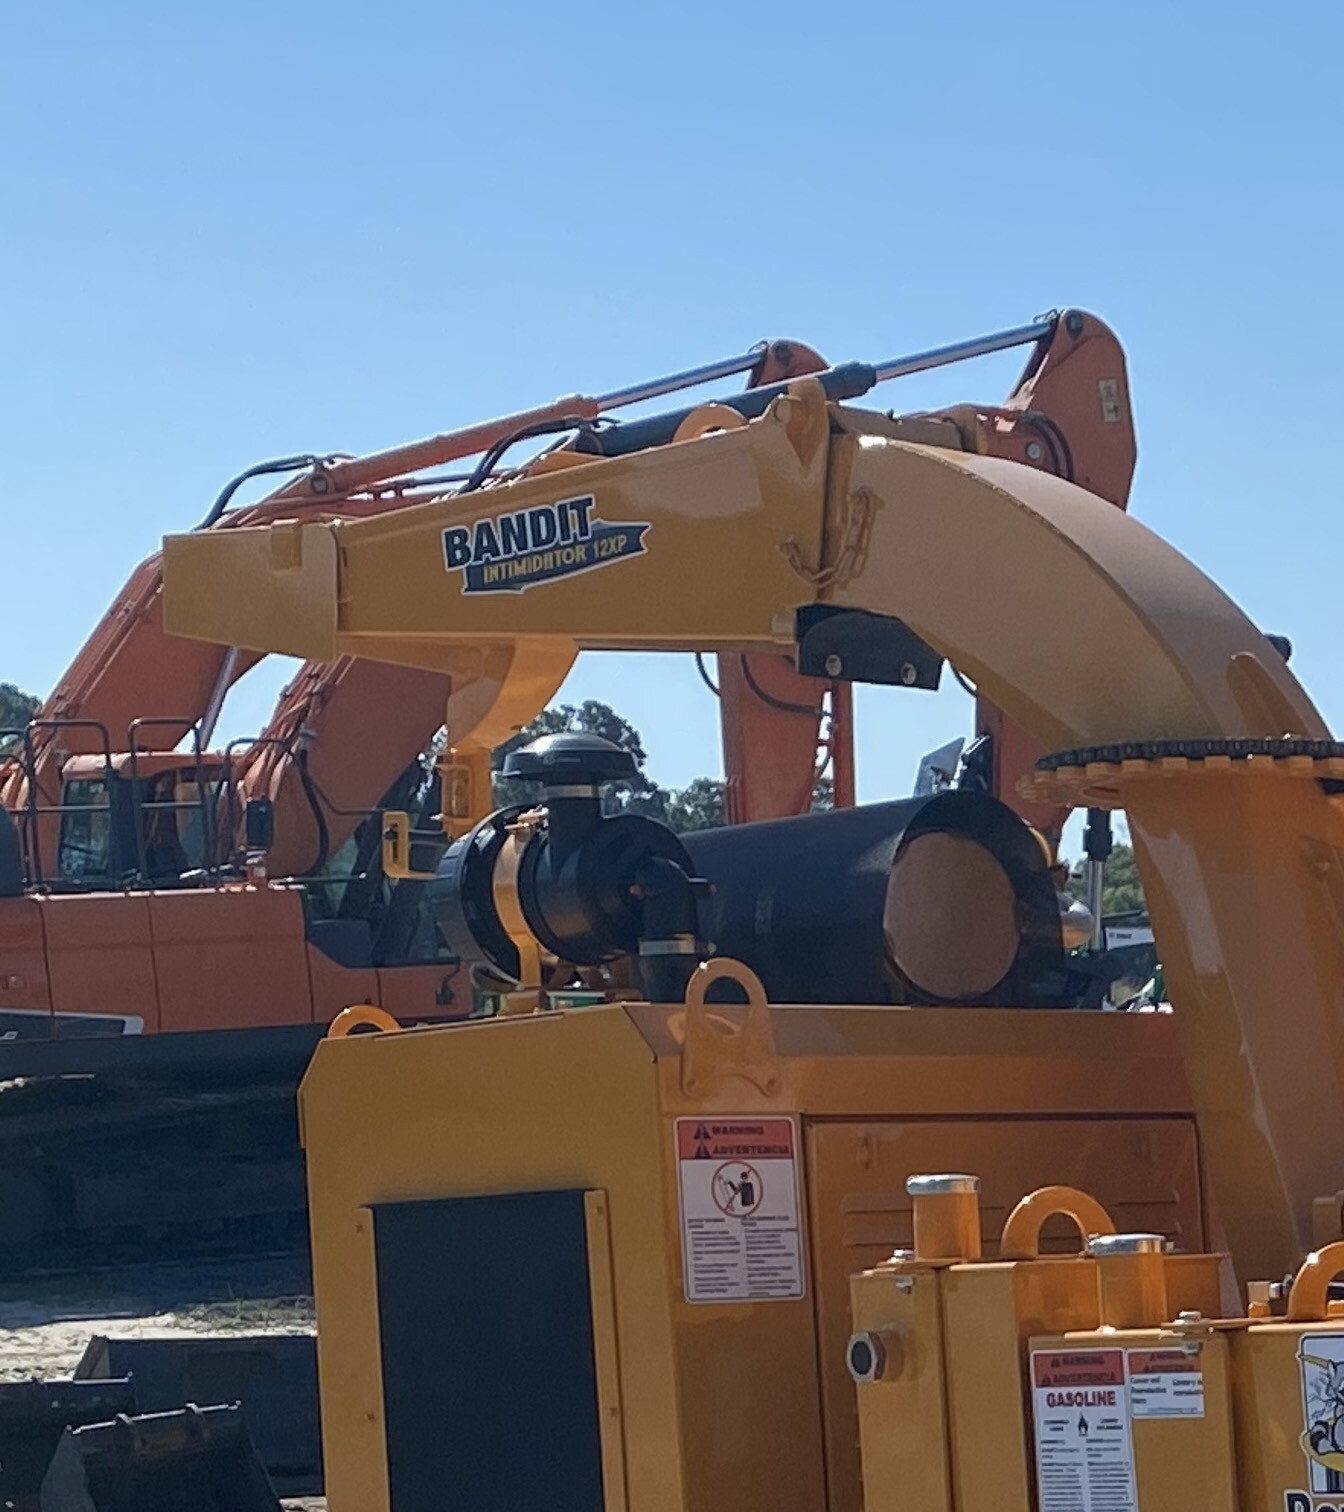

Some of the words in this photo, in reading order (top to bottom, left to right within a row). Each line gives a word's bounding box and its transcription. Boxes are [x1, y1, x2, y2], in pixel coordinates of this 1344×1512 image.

[444, 497, 593, 568] BANDIT
[592, 533, 628, 558] 12XP
[1046, 1390, 1117, 1408] GASOLINE
